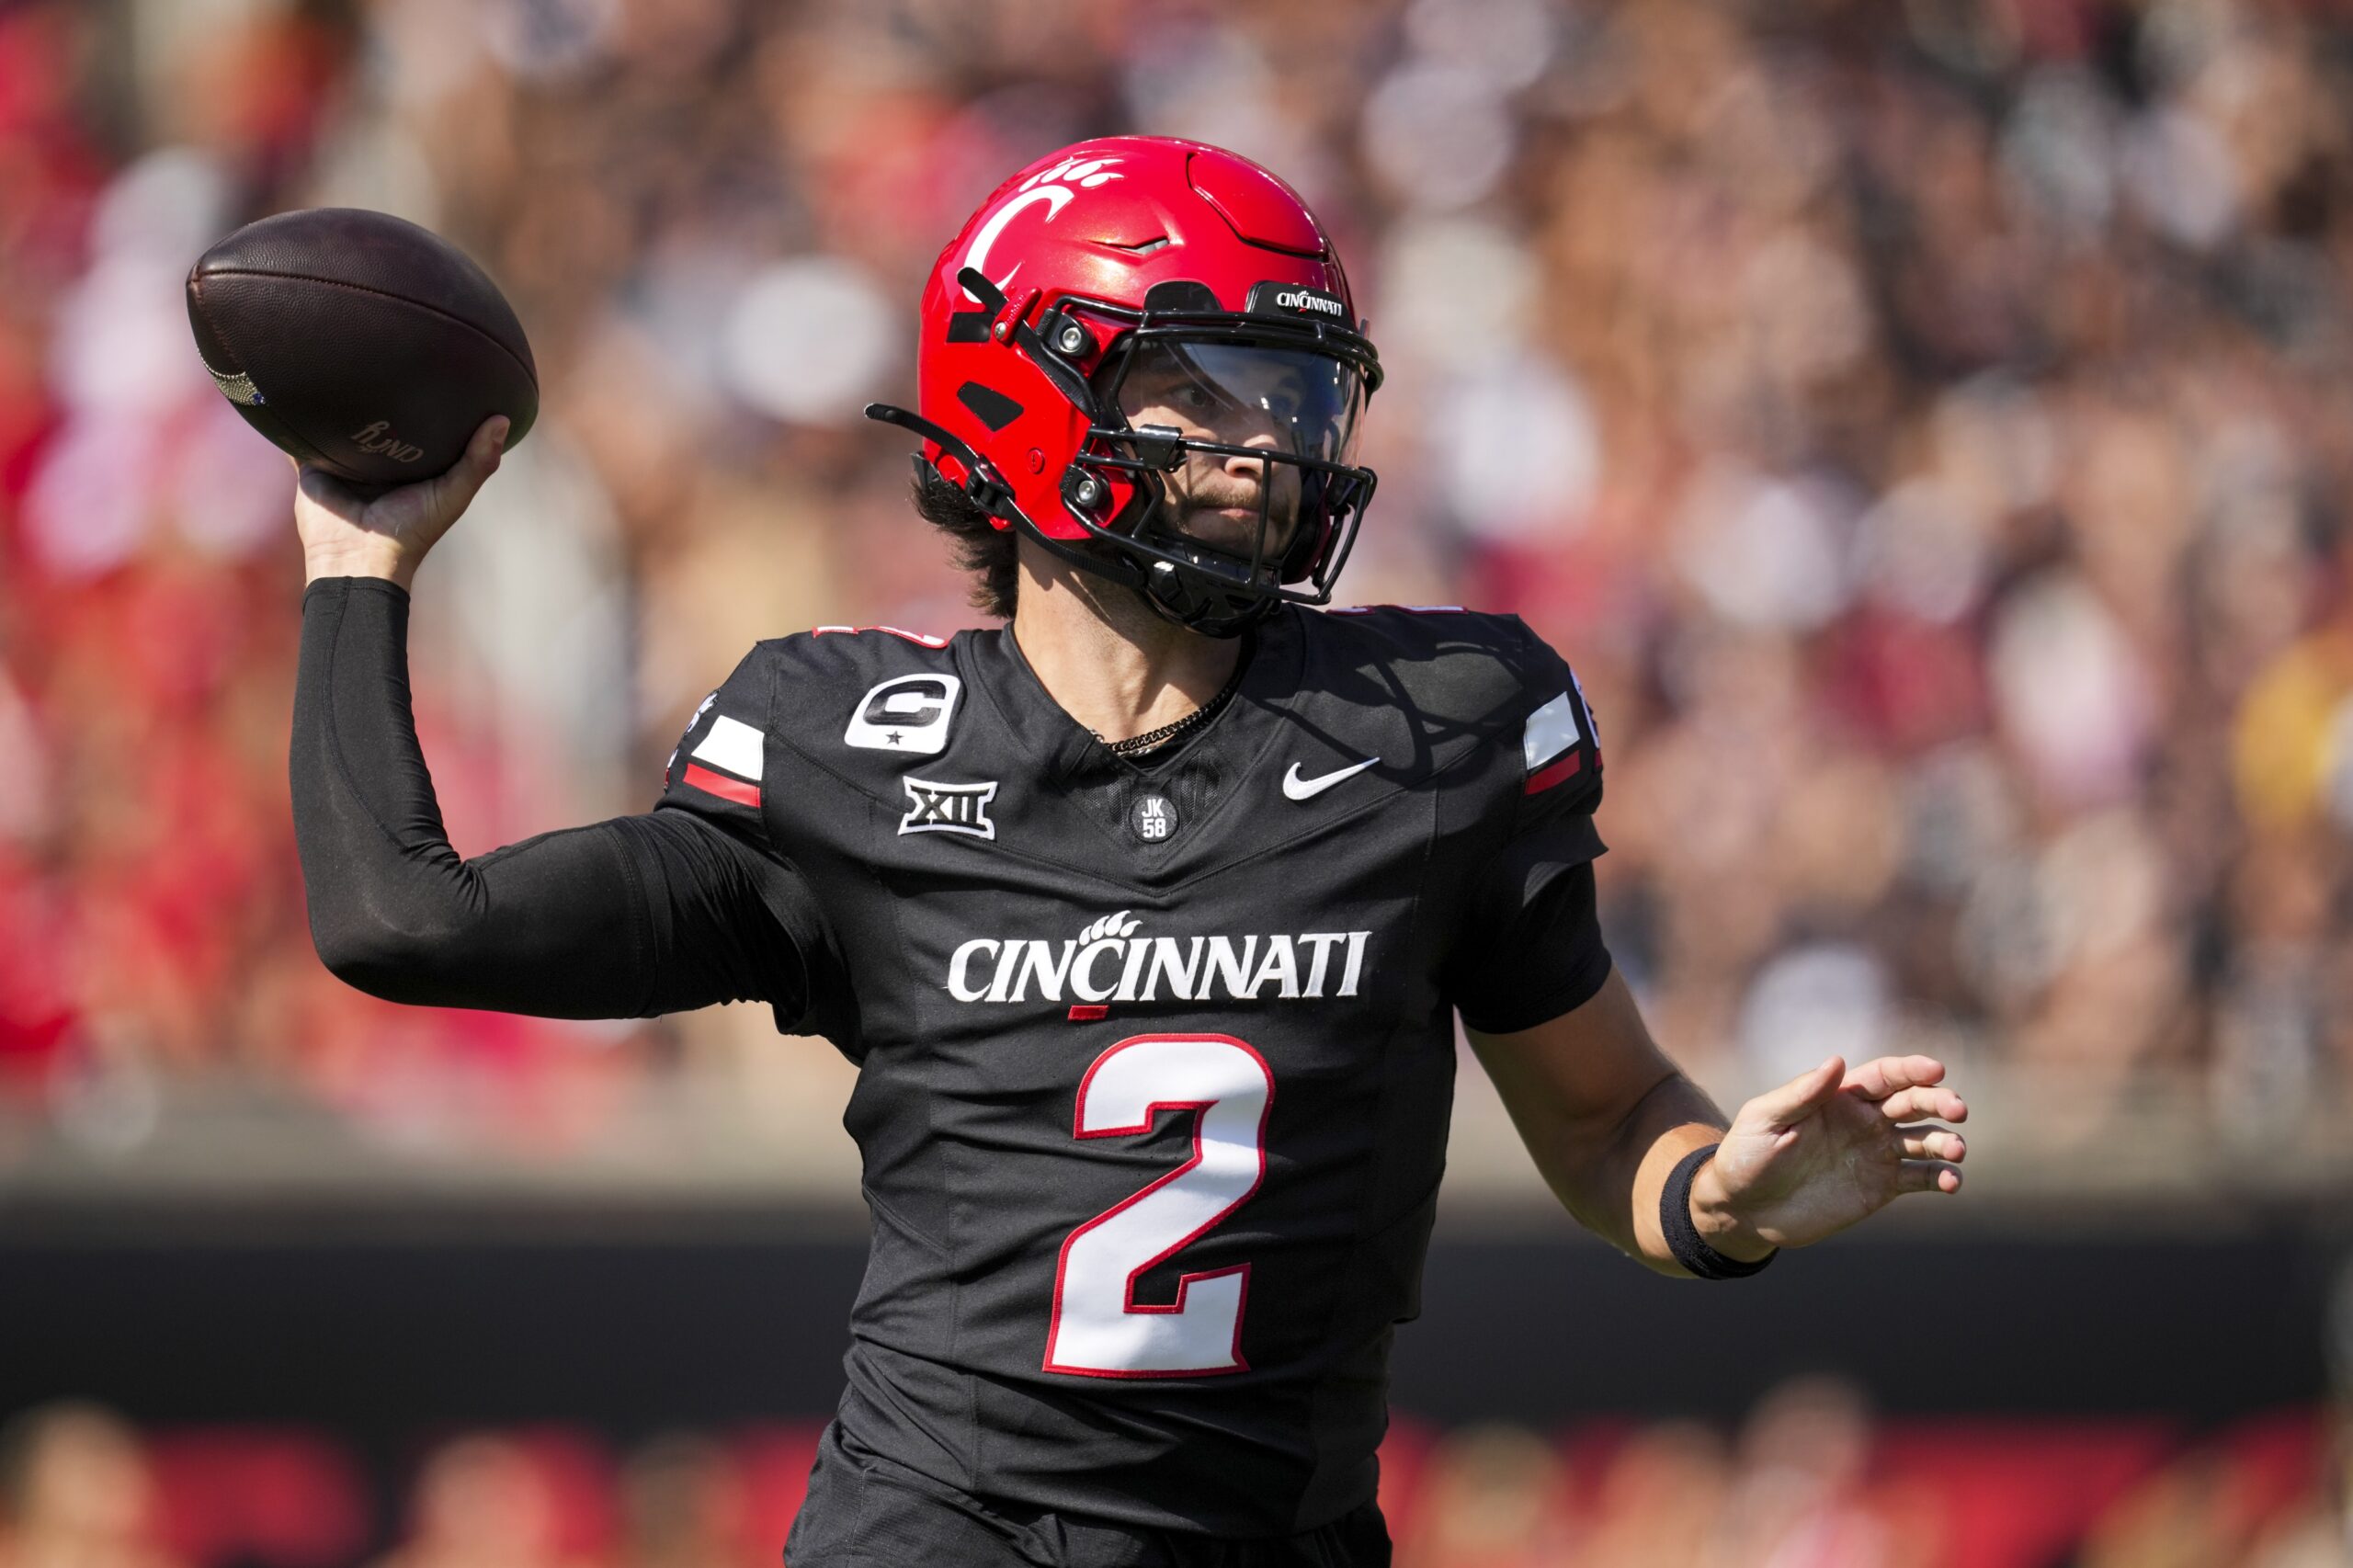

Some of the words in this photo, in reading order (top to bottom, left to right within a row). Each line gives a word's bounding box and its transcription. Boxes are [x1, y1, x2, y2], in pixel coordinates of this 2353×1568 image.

[1276, 291, 1342, 317] CINCINNATI
[862, 679, 948, 728] C
[905, 783, 993, 832] XII
[1141, 798, 1165, 818] JK
[1142, 818, 1166, 838] 58
[946, 929, 1371, 1004] CINCINNATI
[1042, 1032, 1277, 1379] 2
